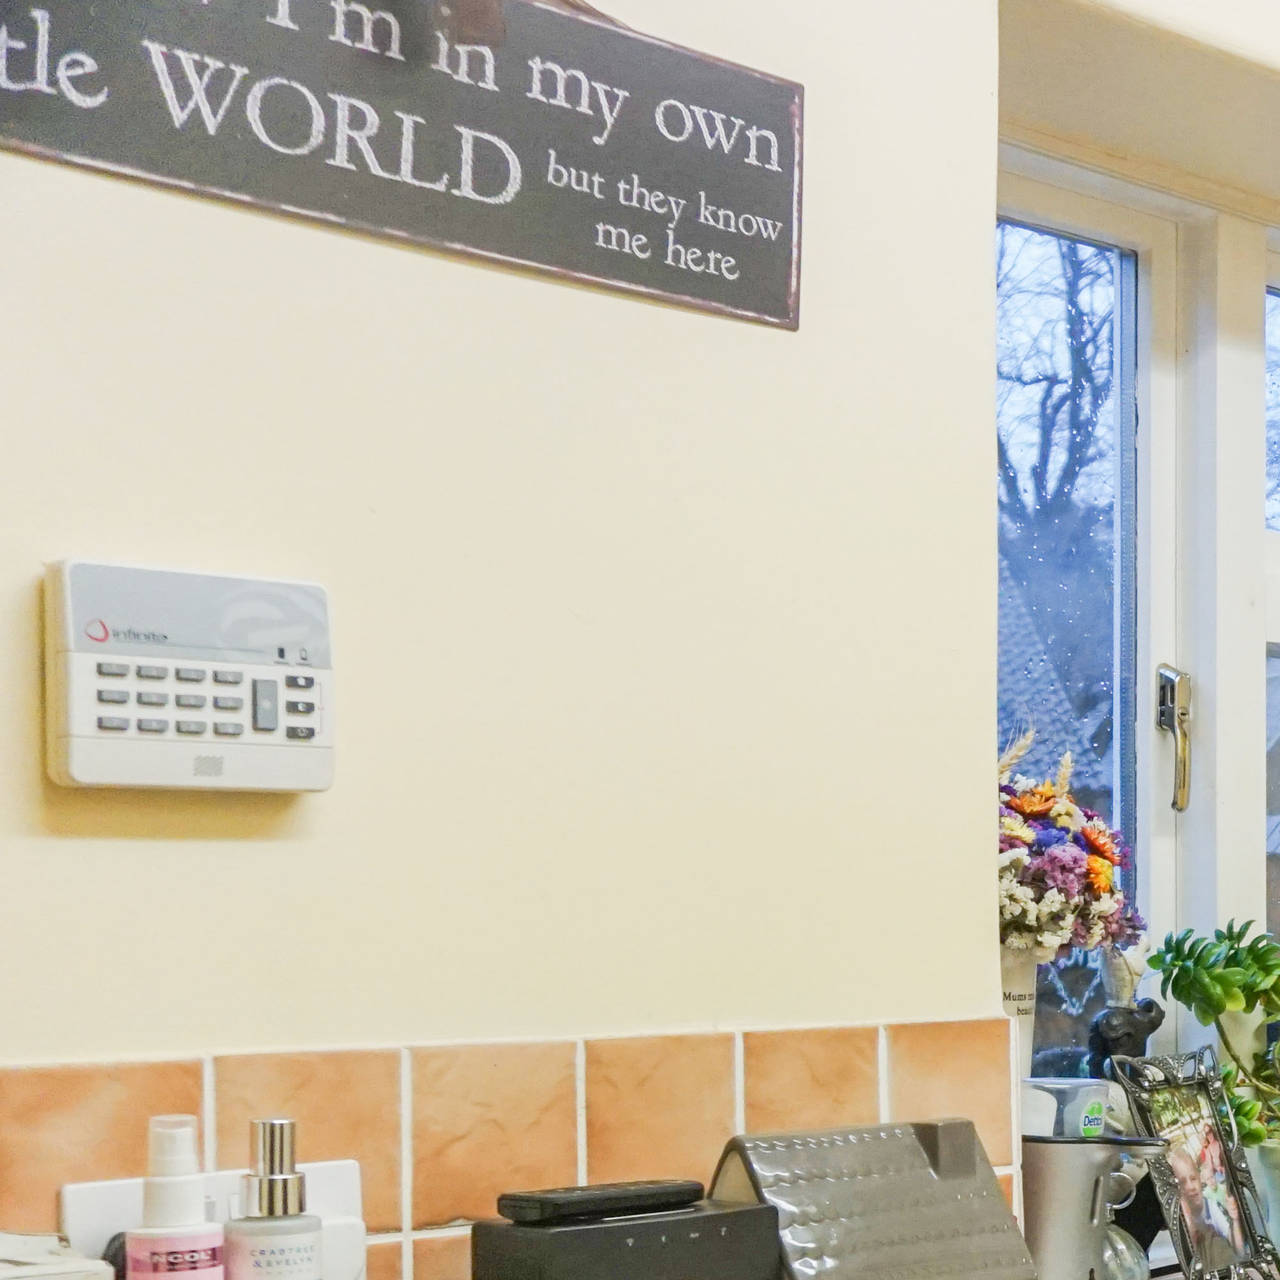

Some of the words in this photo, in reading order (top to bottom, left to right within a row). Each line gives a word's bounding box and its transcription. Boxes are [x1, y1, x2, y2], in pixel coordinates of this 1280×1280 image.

[141, 40, 522, 204] WORLD
[431, 7, 500, 92] in
[526, 56, 631, 145] my
[655, 99, 784, 172] own
[547, 149, 606, 200] but
[617, 174, 688, 229] they
[698, 192, 784, 242] know
[595, 222, 652, 260] me
[664, 229, 740, 281] here
